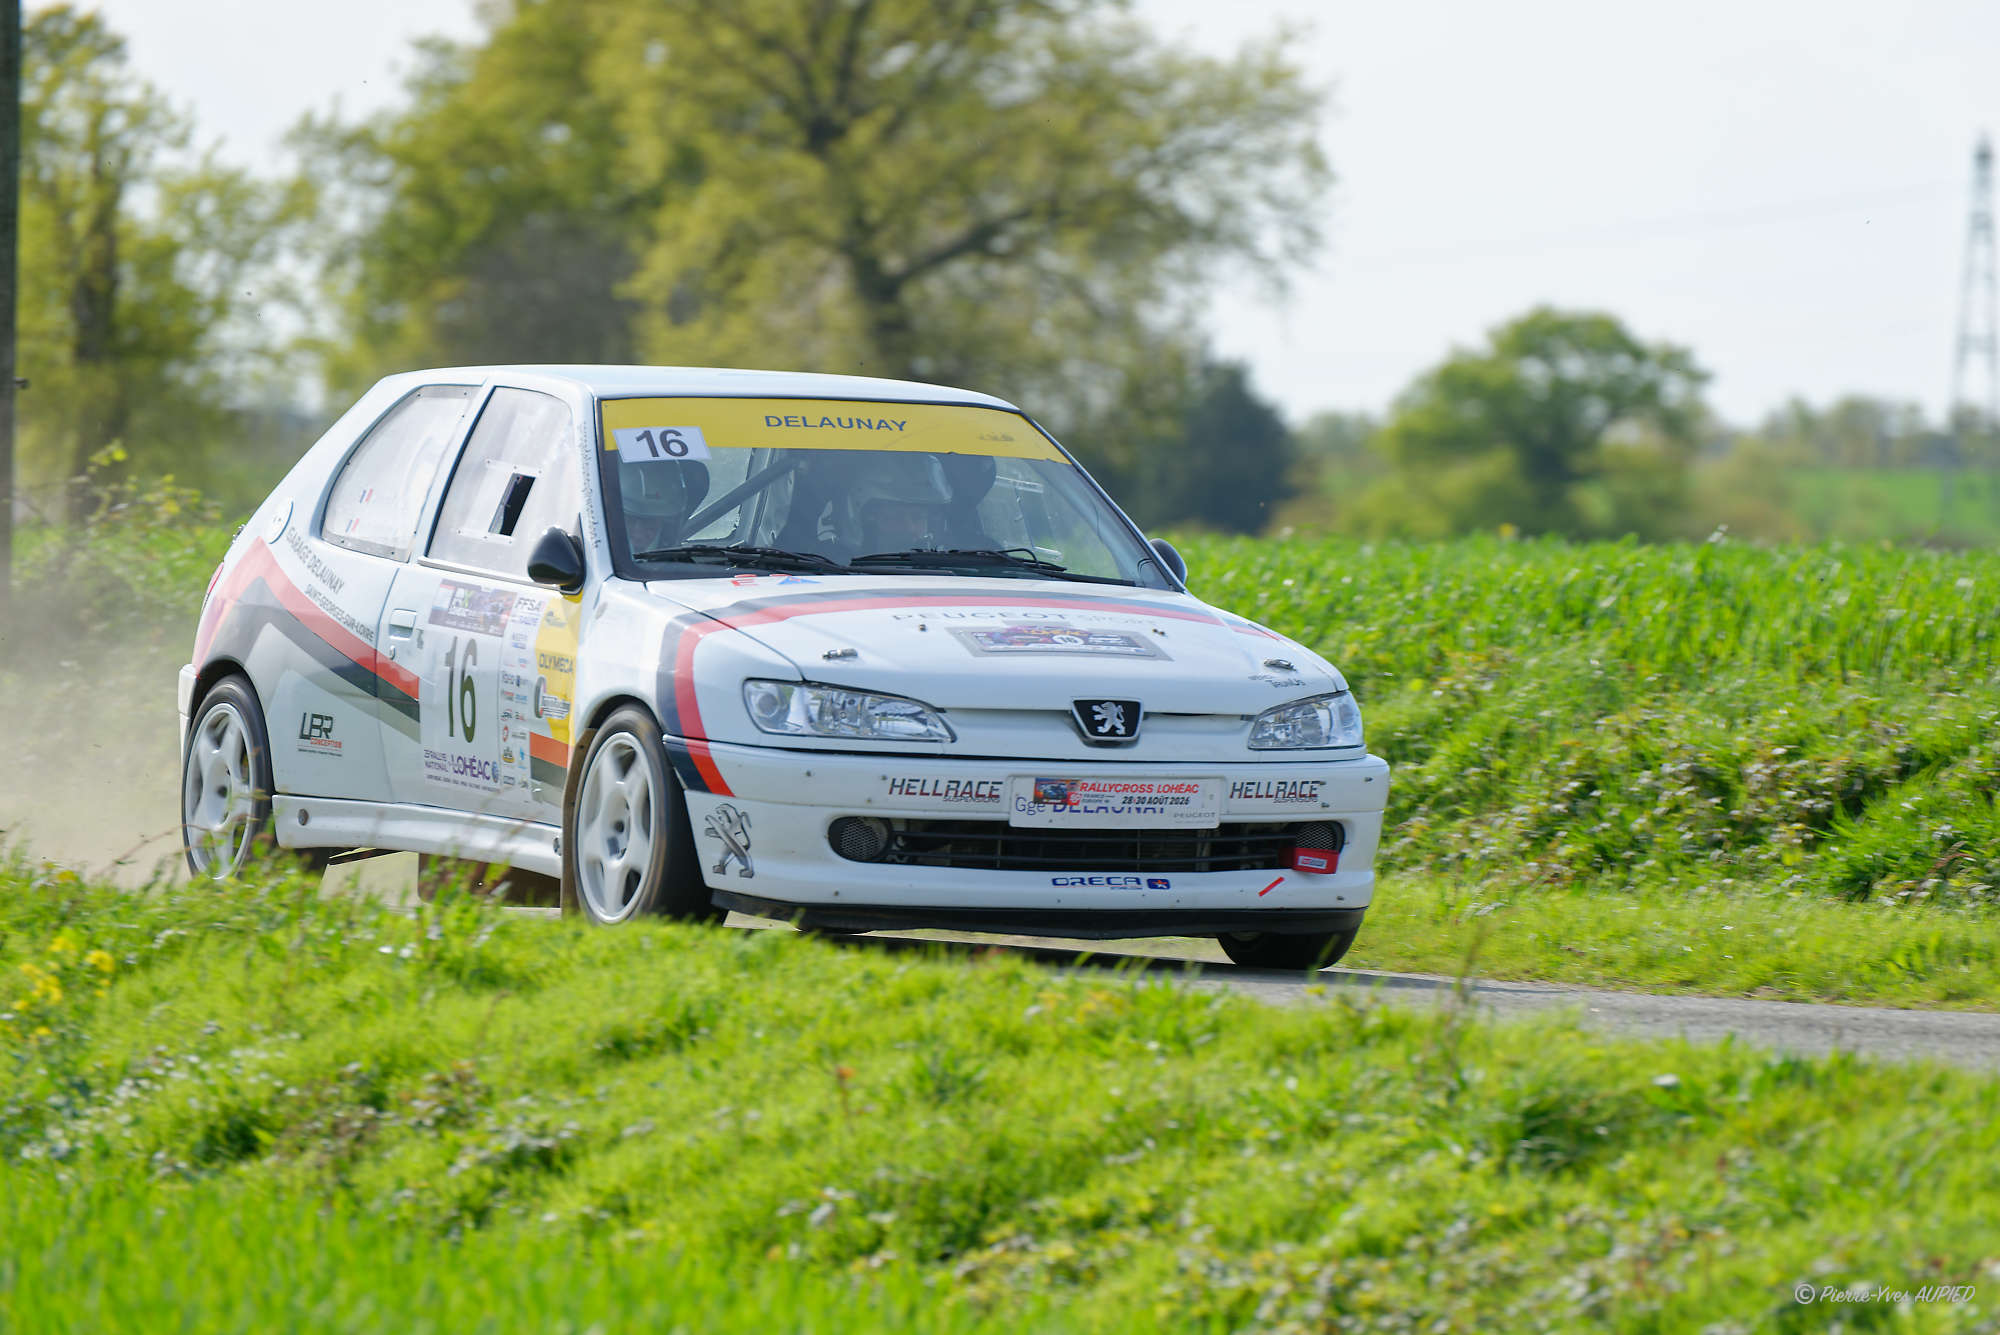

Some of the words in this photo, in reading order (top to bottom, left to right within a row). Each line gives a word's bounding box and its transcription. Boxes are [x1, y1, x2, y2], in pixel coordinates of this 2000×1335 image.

[764, 414, 907, 432] DELAUNAY
[635, 429, 689, 458] 16
[285, 525, 314, 564] GARAGE
[307, 553, 345, 596] DELAUNAY
[892, 611, 1066, 621] PEUGEOT
[539, 653, 575, 673] OLYMECA
[444, 635, 478, 743] 16
[299, 712, 334, 740] LBR
[450, 754, 491, 781] LOHÉAC
[888, 778, 1003, 799] HELLRACE
[1080, 783, 1153, 793] RALLYCROSS
[1157, 782, 1200, 794] LOHÉAC
[1230, 780, 1323, 799] HELLRACE
[1015, 796, 1046, 815] Gge
[1051, 876, 1142, 887] ORECA
